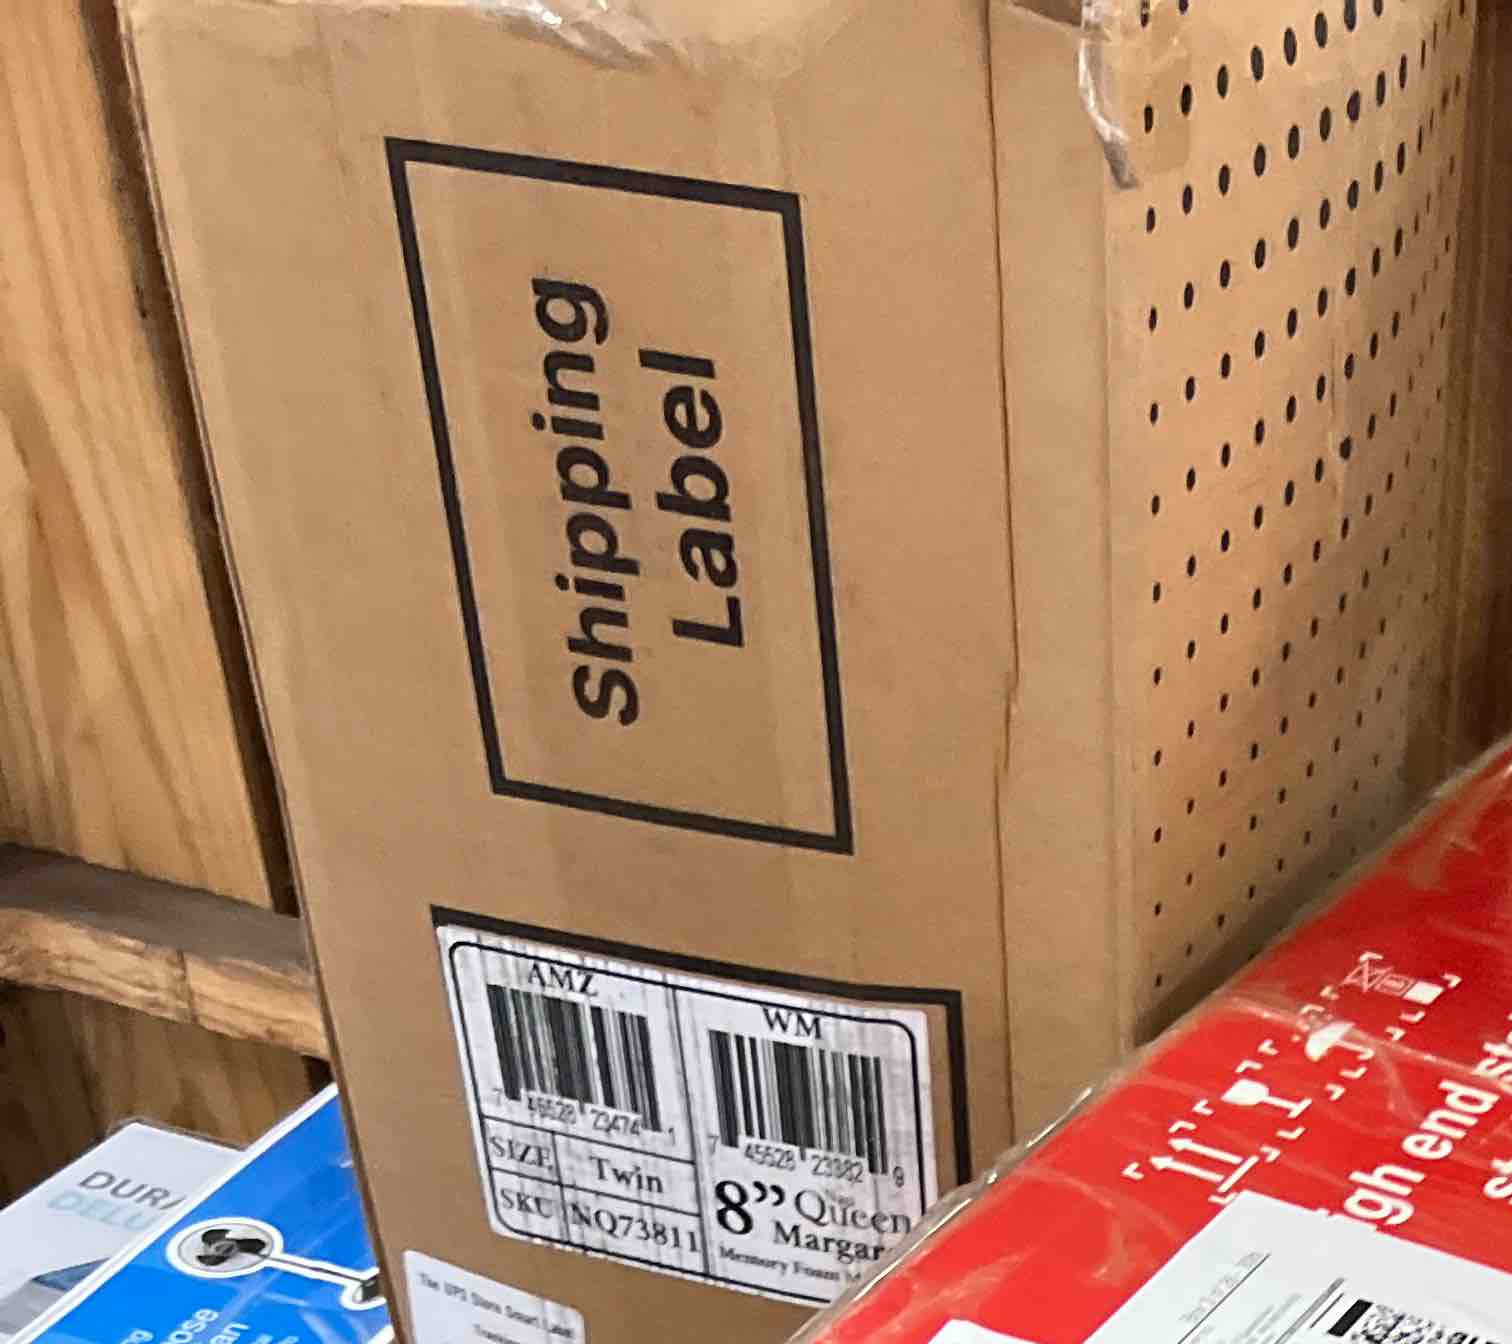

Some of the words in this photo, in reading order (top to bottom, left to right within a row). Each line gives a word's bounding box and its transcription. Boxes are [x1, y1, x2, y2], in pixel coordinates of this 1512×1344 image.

[530, 277, 641, 727] Shipping
[638, 347, 746, 649] Label
[527, 962, 599, 998] AMZ
[762, 1006, 823, 1040] WM
[1400, 1078, 1502, 1164] end
[589, 1155, 664, 1195] Twin
[570, 1202, 699, 1253] NQ73811
[794, 1188, 912, 1235] Queen
[772, 1220, 888, 1265] Margar
